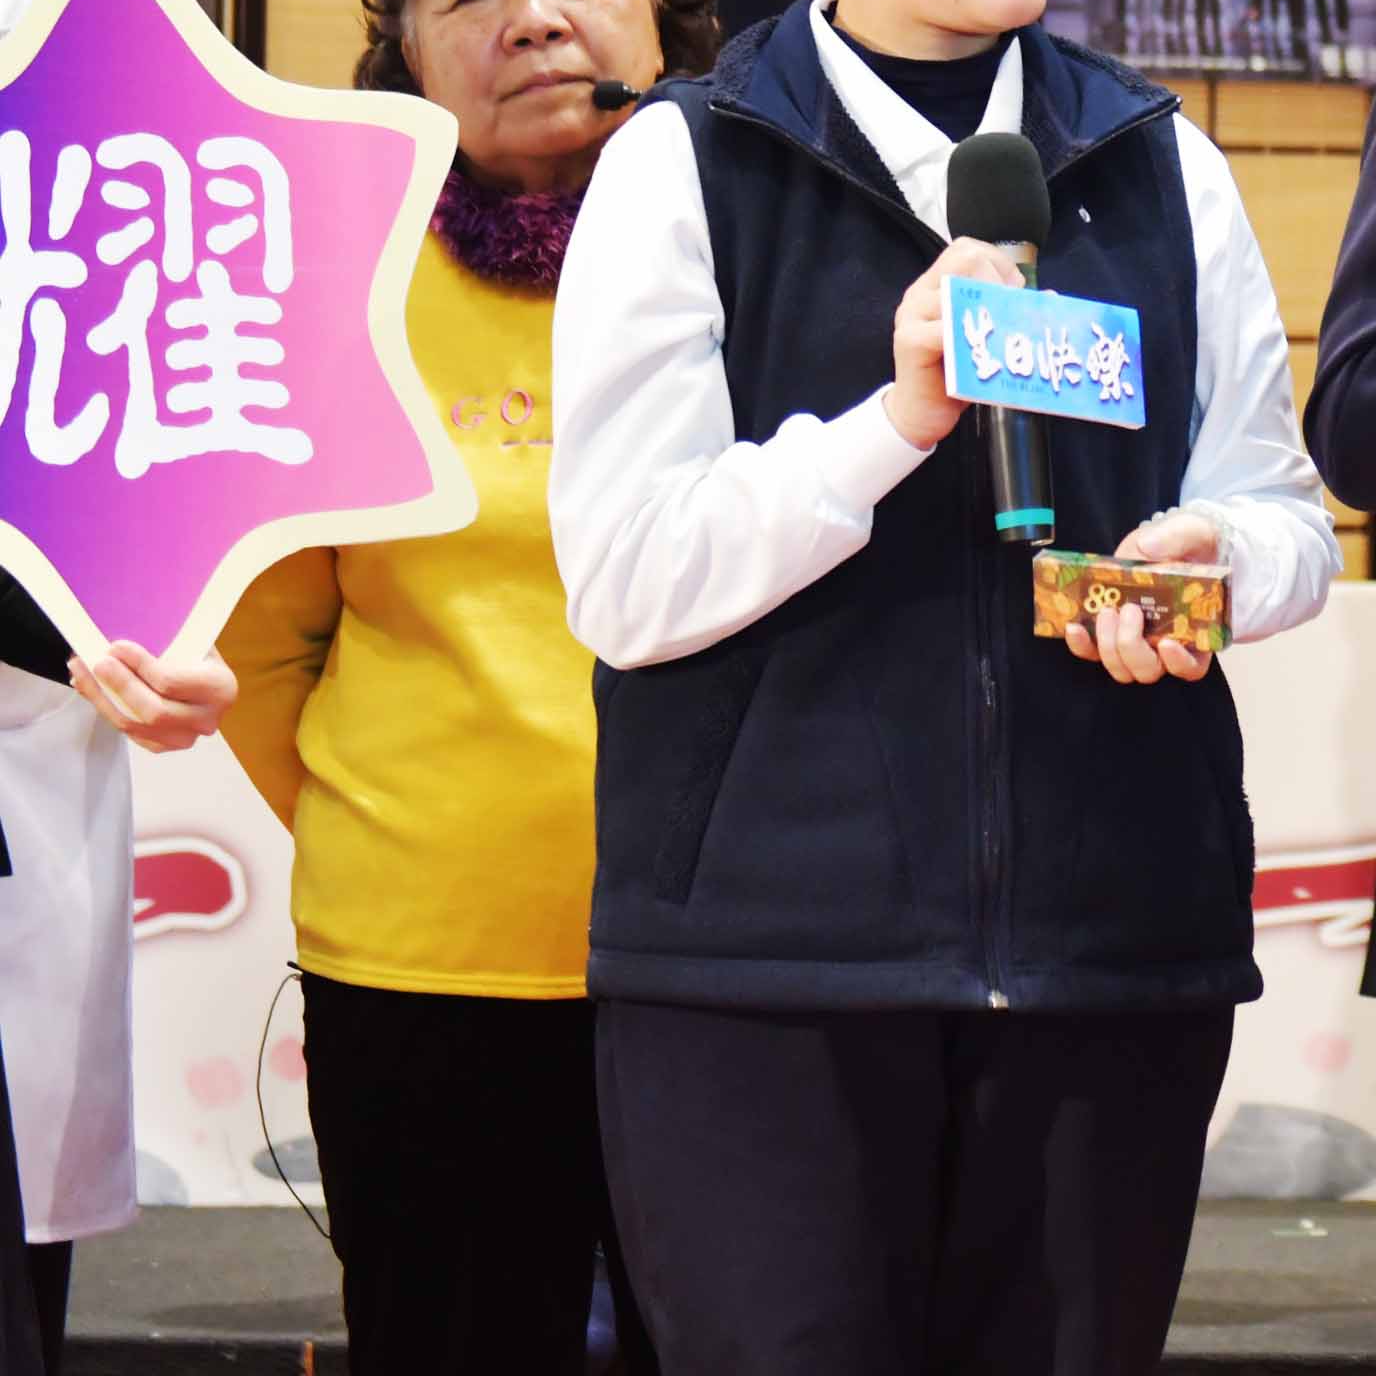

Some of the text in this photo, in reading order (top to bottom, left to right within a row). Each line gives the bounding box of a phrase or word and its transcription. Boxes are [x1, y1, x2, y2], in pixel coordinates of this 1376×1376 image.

[0, 129, 314, 479] 耀
[962, 305, 1136, 401] 生日快樂
